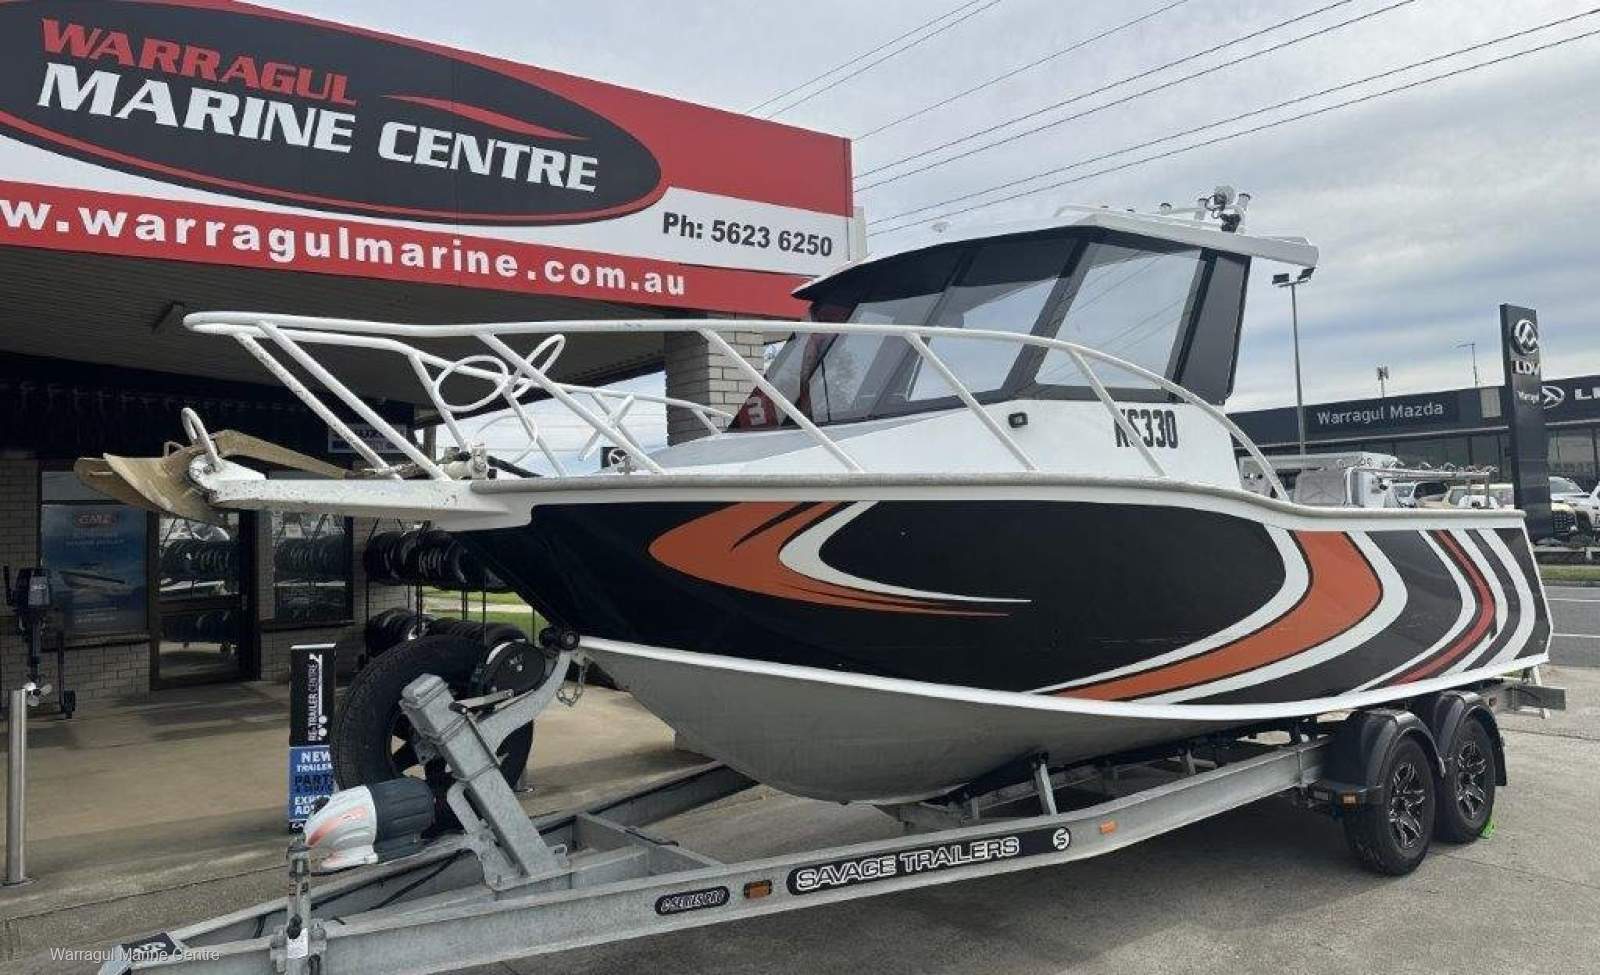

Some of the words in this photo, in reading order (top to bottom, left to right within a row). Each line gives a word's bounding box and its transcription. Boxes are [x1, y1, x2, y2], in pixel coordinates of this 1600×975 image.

[41, 18, 357, 105] WARRAGUL
[37, 62, 357, 154] MARINE
[377, 120, 599, 193] CENTRE
[663, 212, 703, 239] Ph:
[711, 219, 770, 249] 5623
[778, 230, 832, 257] 6250
[1317, 407, 1385, 425] Warragul
[1390, 402, 1443, 419] Mazda
[308, 663, 318, 693] CENTRE
[301, 751, 331, 763] NEW
[797, 855, 896, 892] SAVAGE
[900, 836, 1020, 872] TRAILERS
